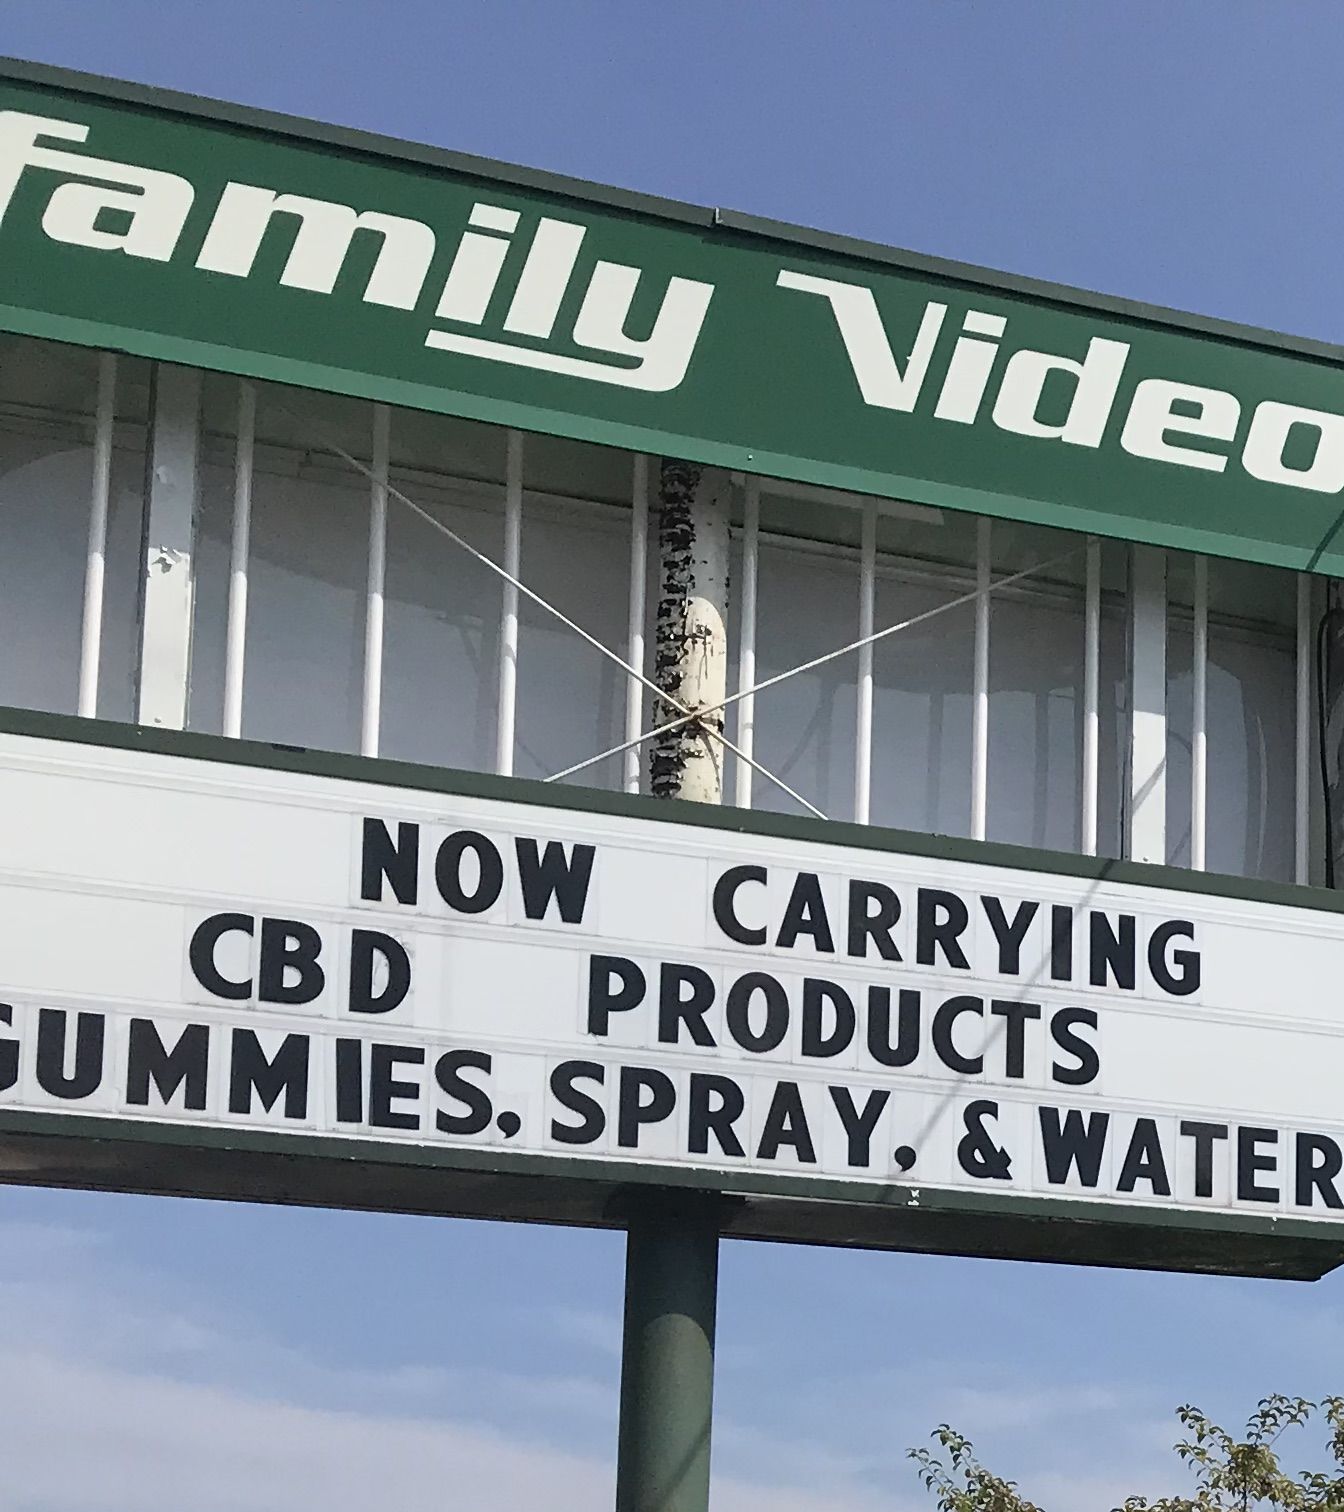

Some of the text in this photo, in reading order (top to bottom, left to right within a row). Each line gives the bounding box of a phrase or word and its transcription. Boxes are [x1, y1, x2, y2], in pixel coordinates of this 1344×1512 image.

[0, 109, 715, 393] family
[360, 817, 1202, 998] NOW CARRYING
[189, 911, 1101, 1087] CBD PRODUCTS
[550, 1060, 918, 1173] SPRAY,
[957, 1098, 1013, 1183] &
[1036, 1104, 1344, 1212] WATER
